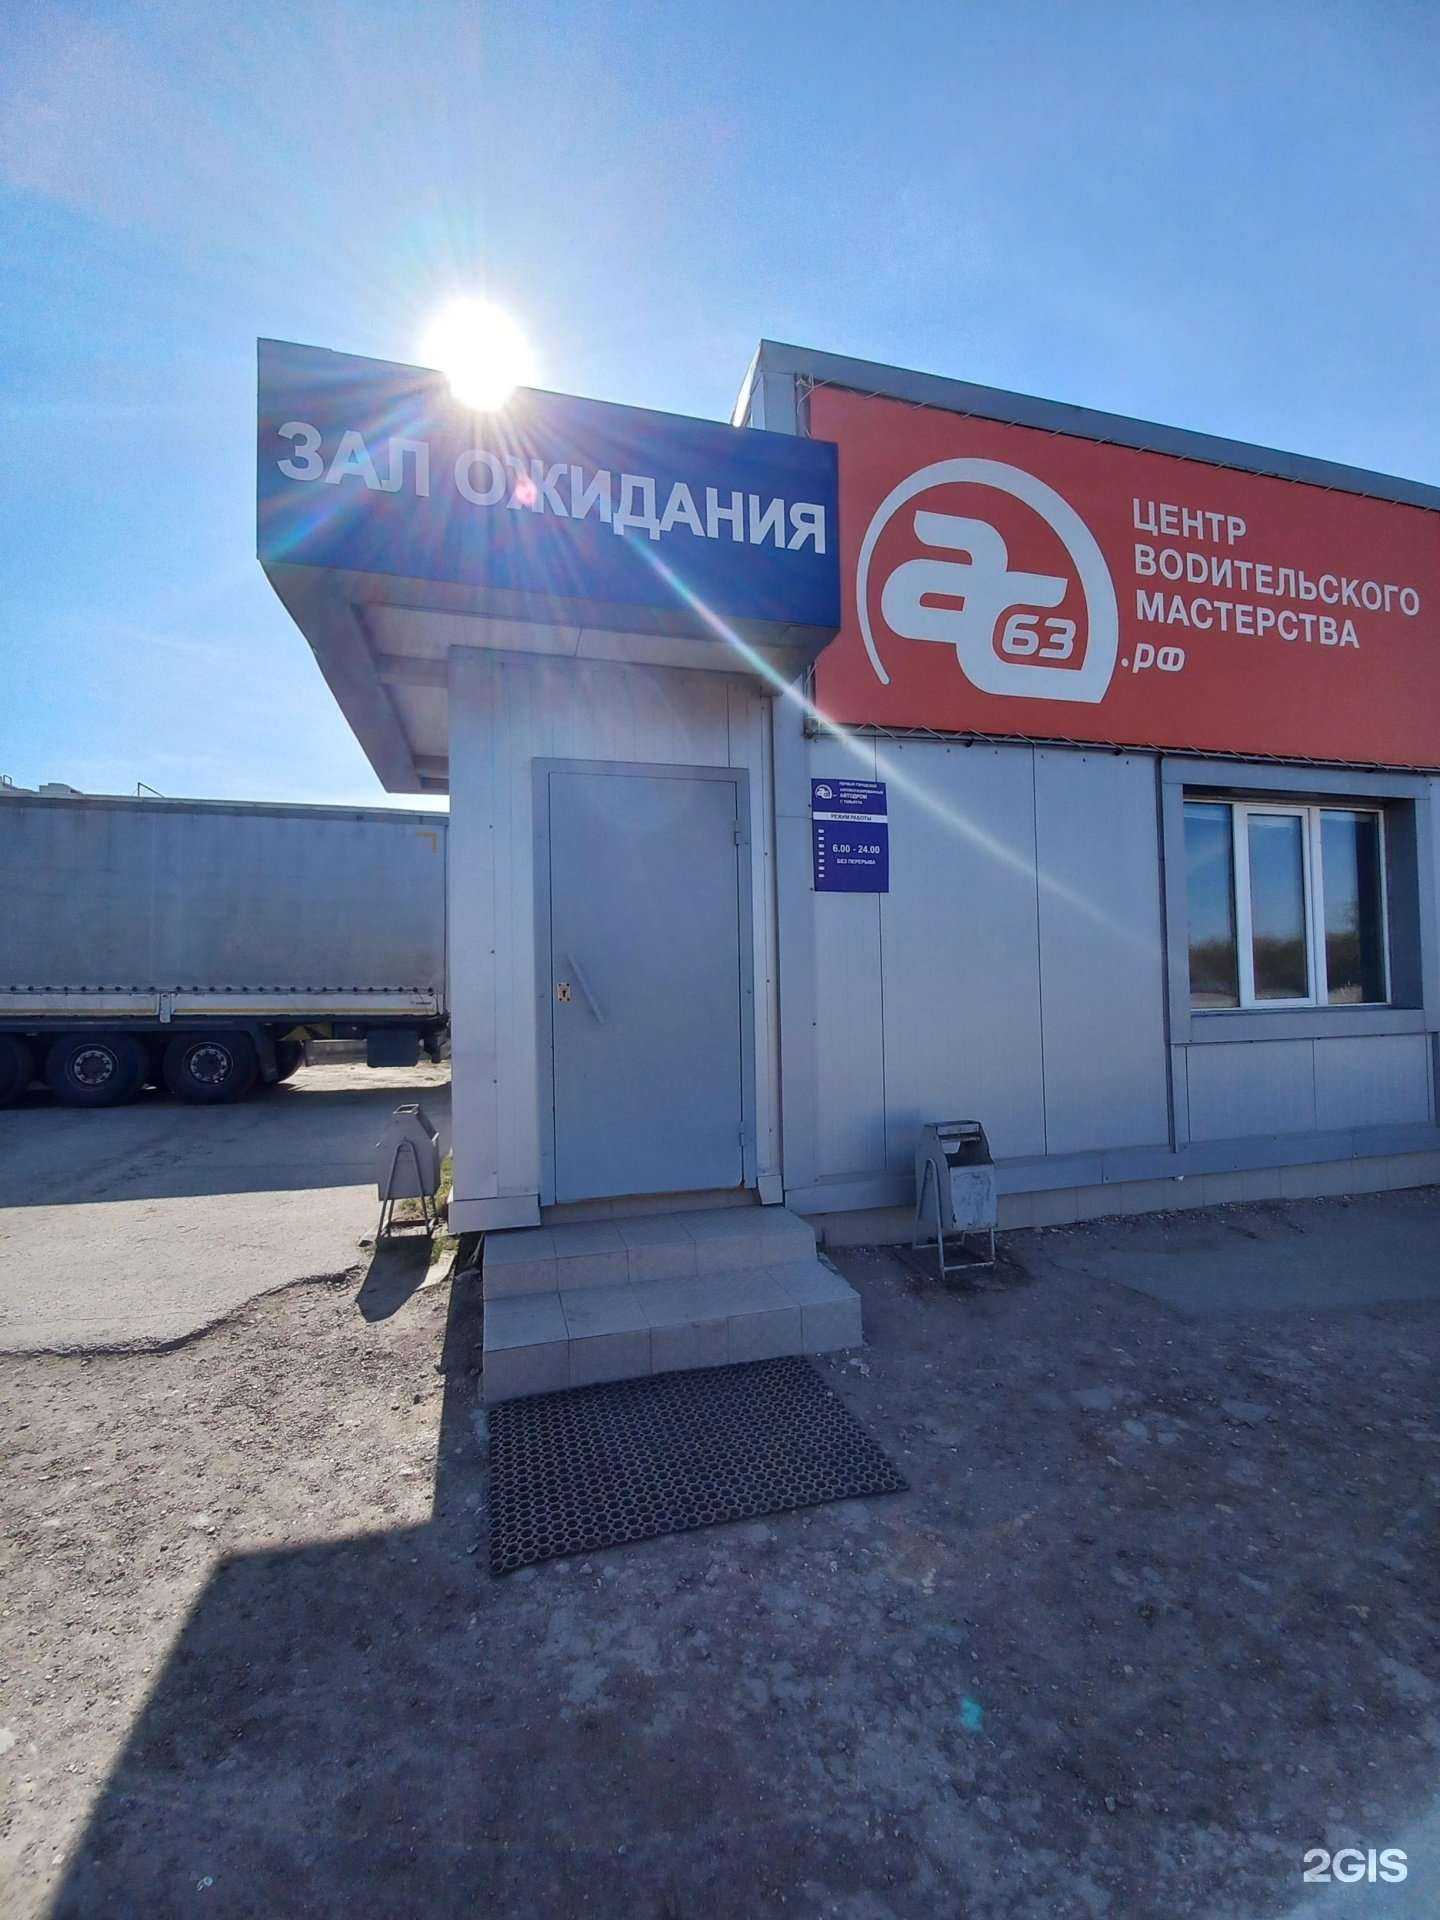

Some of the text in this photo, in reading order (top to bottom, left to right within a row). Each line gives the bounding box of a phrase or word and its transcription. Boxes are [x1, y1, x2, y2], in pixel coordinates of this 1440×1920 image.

[277, 421, 826, 554] ЗАЛ ОЖИДАНИЯ
[1132, 498, 1247, 546] ЦЕНТР
[1136, 590, 1360, 649] МАСТЕРСТВА
[832, 844, 851, 853] 6.00
[857, 845, 880, 854] 24.00
